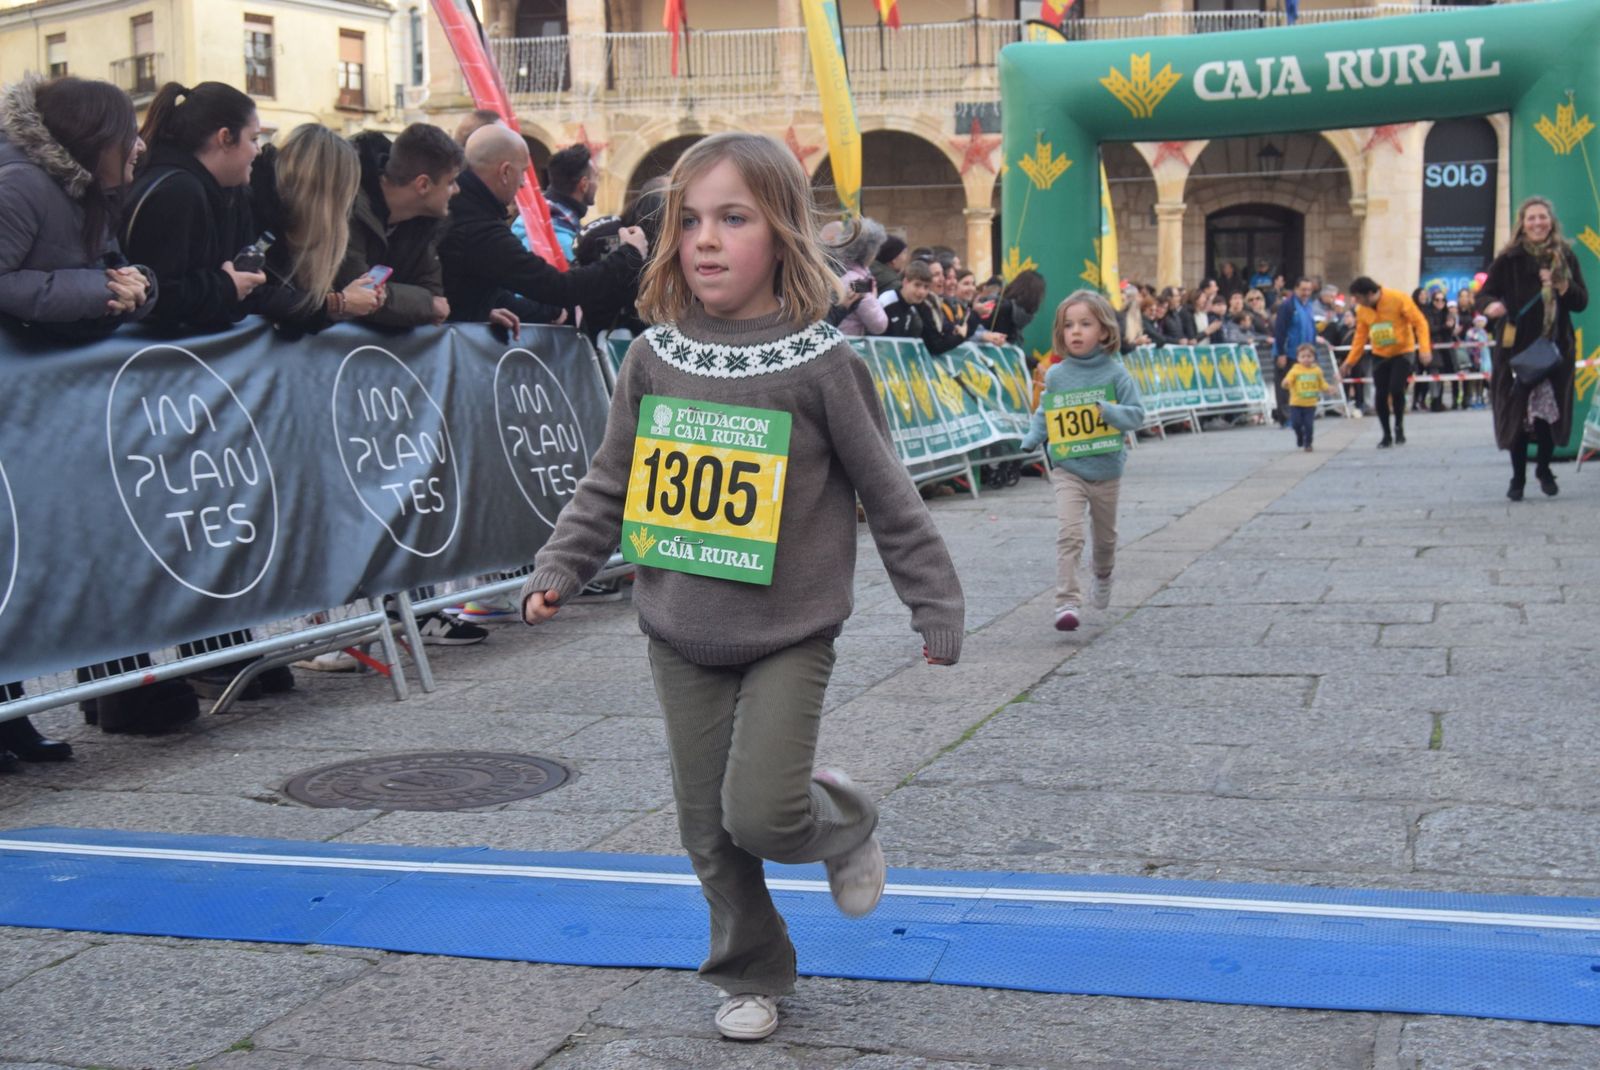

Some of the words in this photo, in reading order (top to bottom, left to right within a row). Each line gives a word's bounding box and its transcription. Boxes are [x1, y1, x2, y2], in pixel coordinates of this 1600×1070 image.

[1193, 56, 1311, 101] CAJA
[1325, 38, 1500, 91] RURAL
[142, 394, 216, 436] IM
[357, 386, 413, 422] IM
[510, 383, 553, 414] IM
[674, 424, 706, 441] CAJA
[711, 429, 767, 448] RURAL
[676, 408, 770, 434] FUNDACION
[1054, 409, 1108, 437] 1304
[349, 430, 446, 473] PLAN
[507, 424, 578, 456] PLAN
[127, 447, 259, 497] PLAN
[530, 464, 578, 497] TES
[644, 448, 761, 526] 1305
[381, 477, 445, 516] TES
[165, 503, 256, 551] TES
[657, 539, 695, 560] CAJA
[699, 545, 763, 570] RURAL
